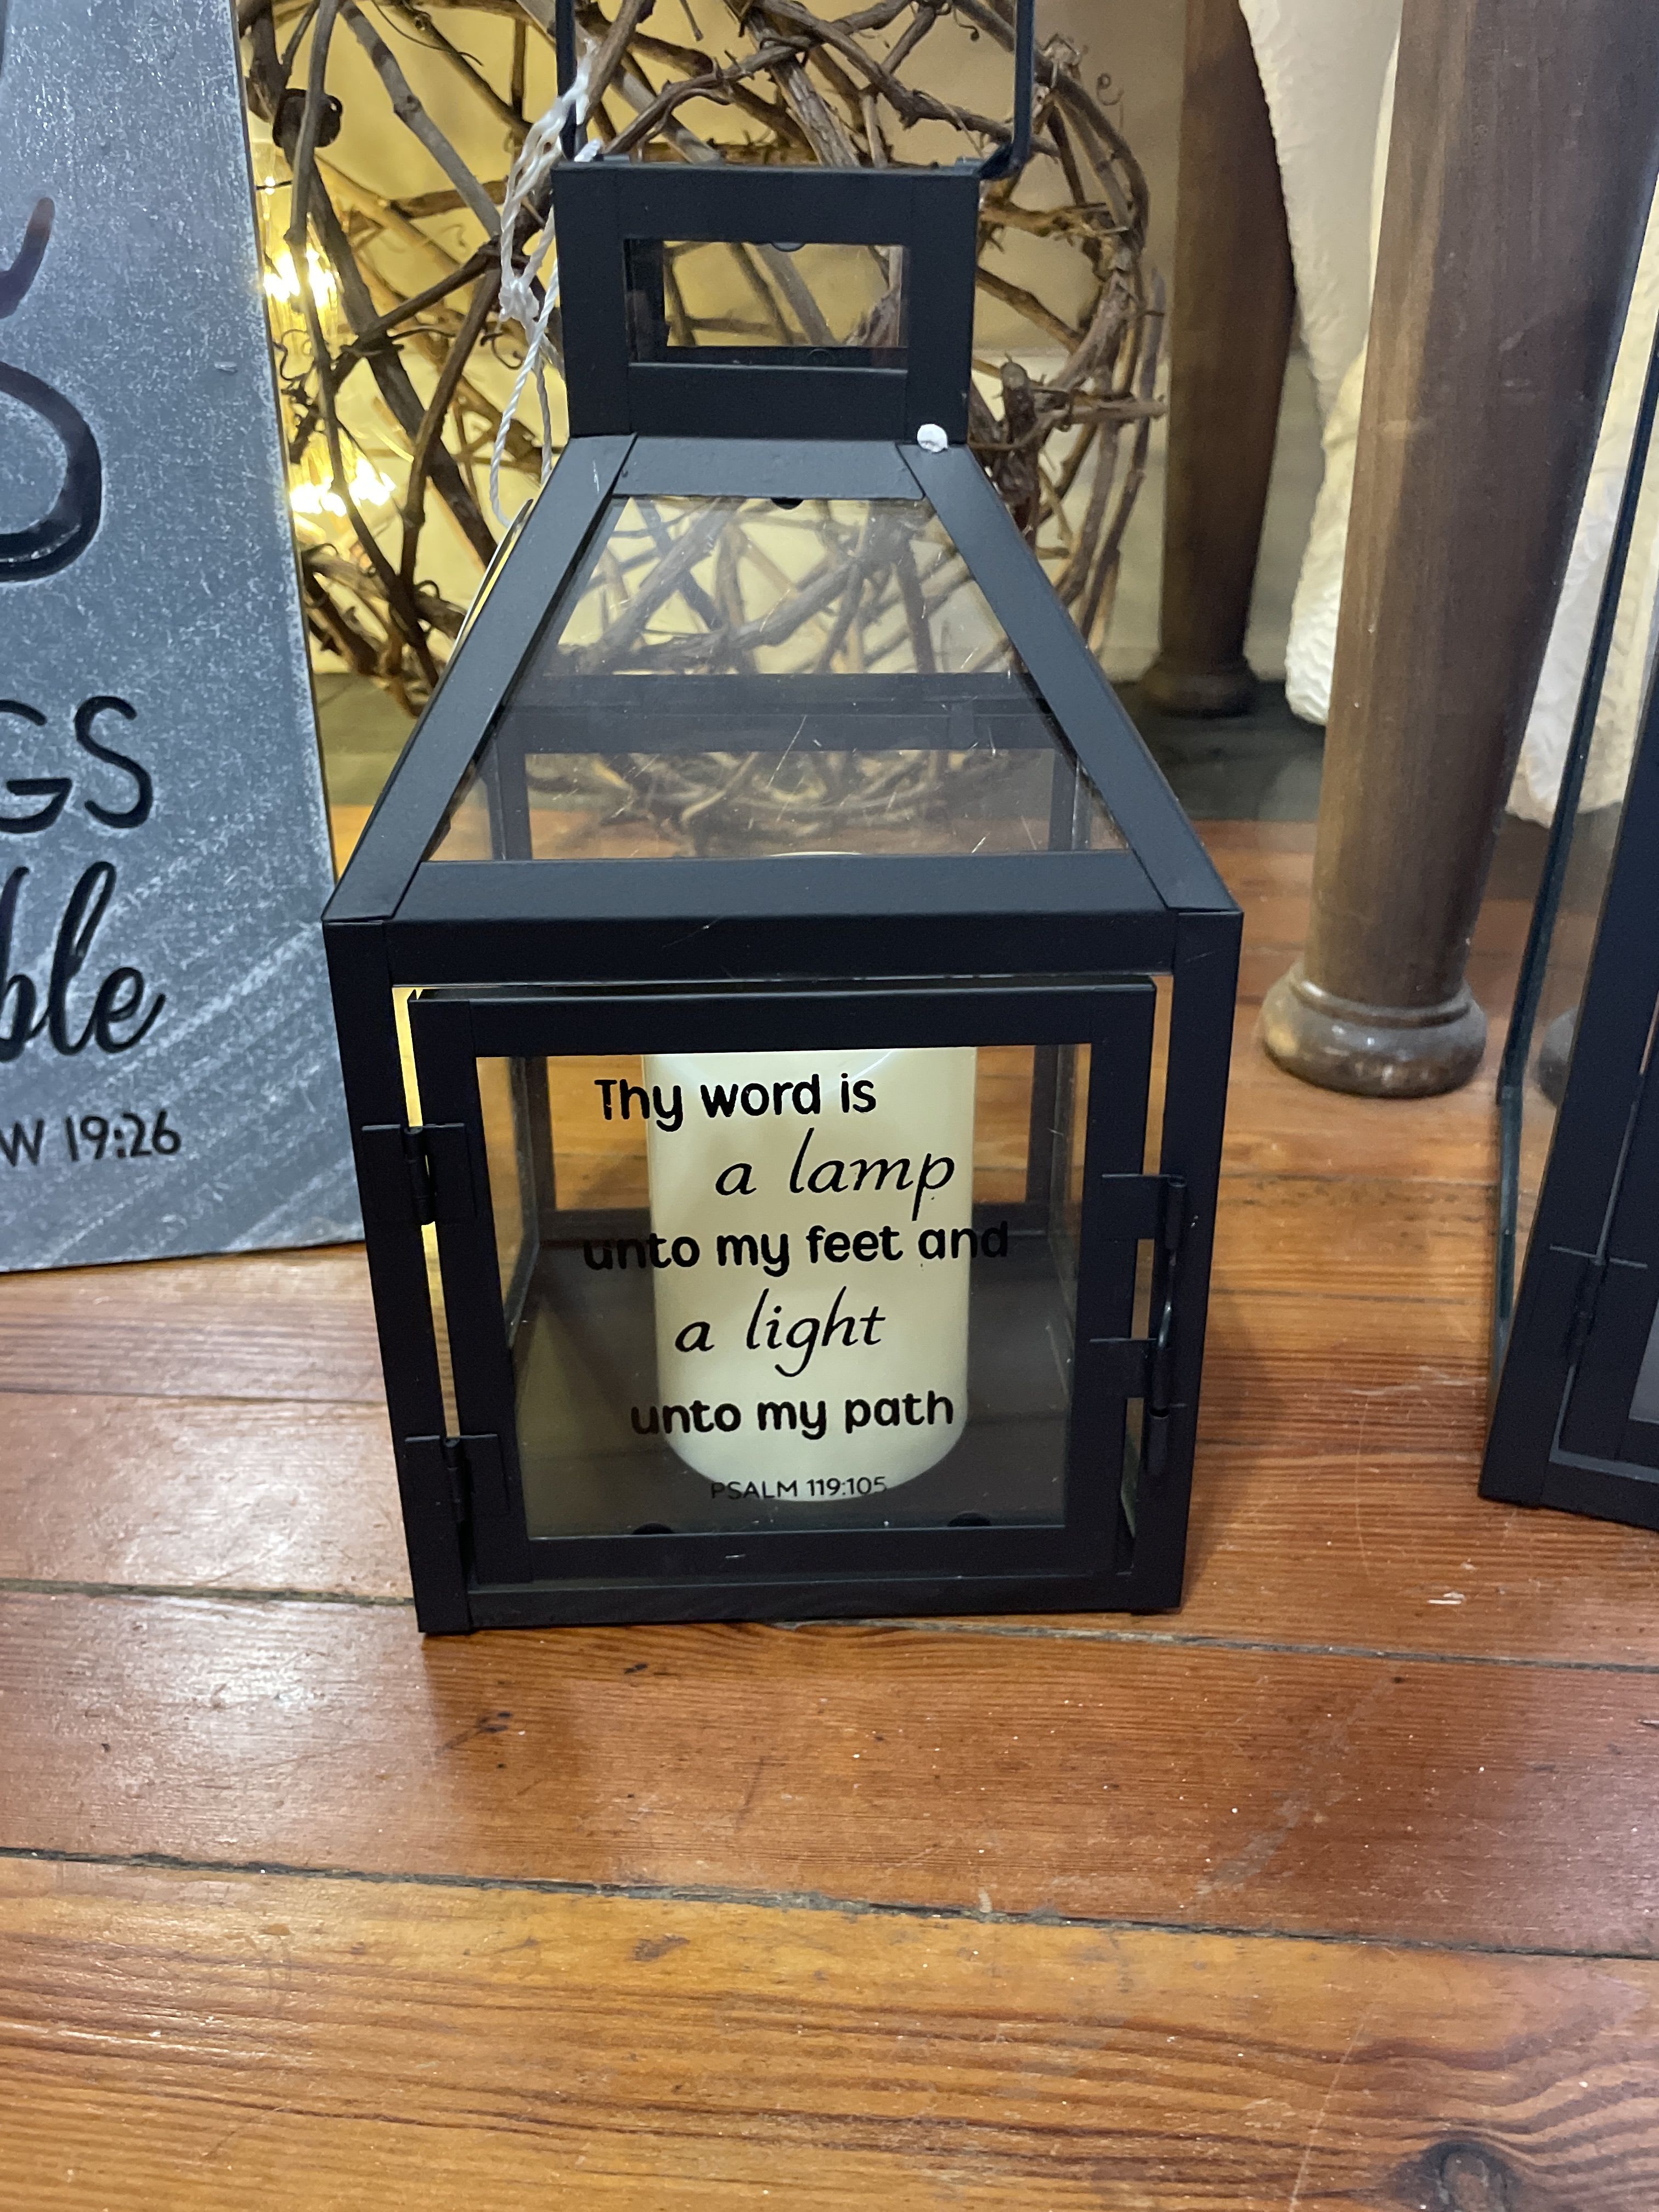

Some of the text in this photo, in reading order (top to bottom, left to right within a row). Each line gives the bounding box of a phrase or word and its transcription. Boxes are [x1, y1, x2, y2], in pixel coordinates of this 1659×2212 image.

[594, 1073, 877, 1132] Thy word is
[66, 1109, 181, 1161] 19:26
[715, 1127, 956, 1221] a lamp
[583, 1221, 1009, 1277] unto my feet and
[674, 1285, 887, 1377] a light
[631, 1391, 953, 1440] unto my path
[710, 1476, 887, 1500] PSALM 119:105
